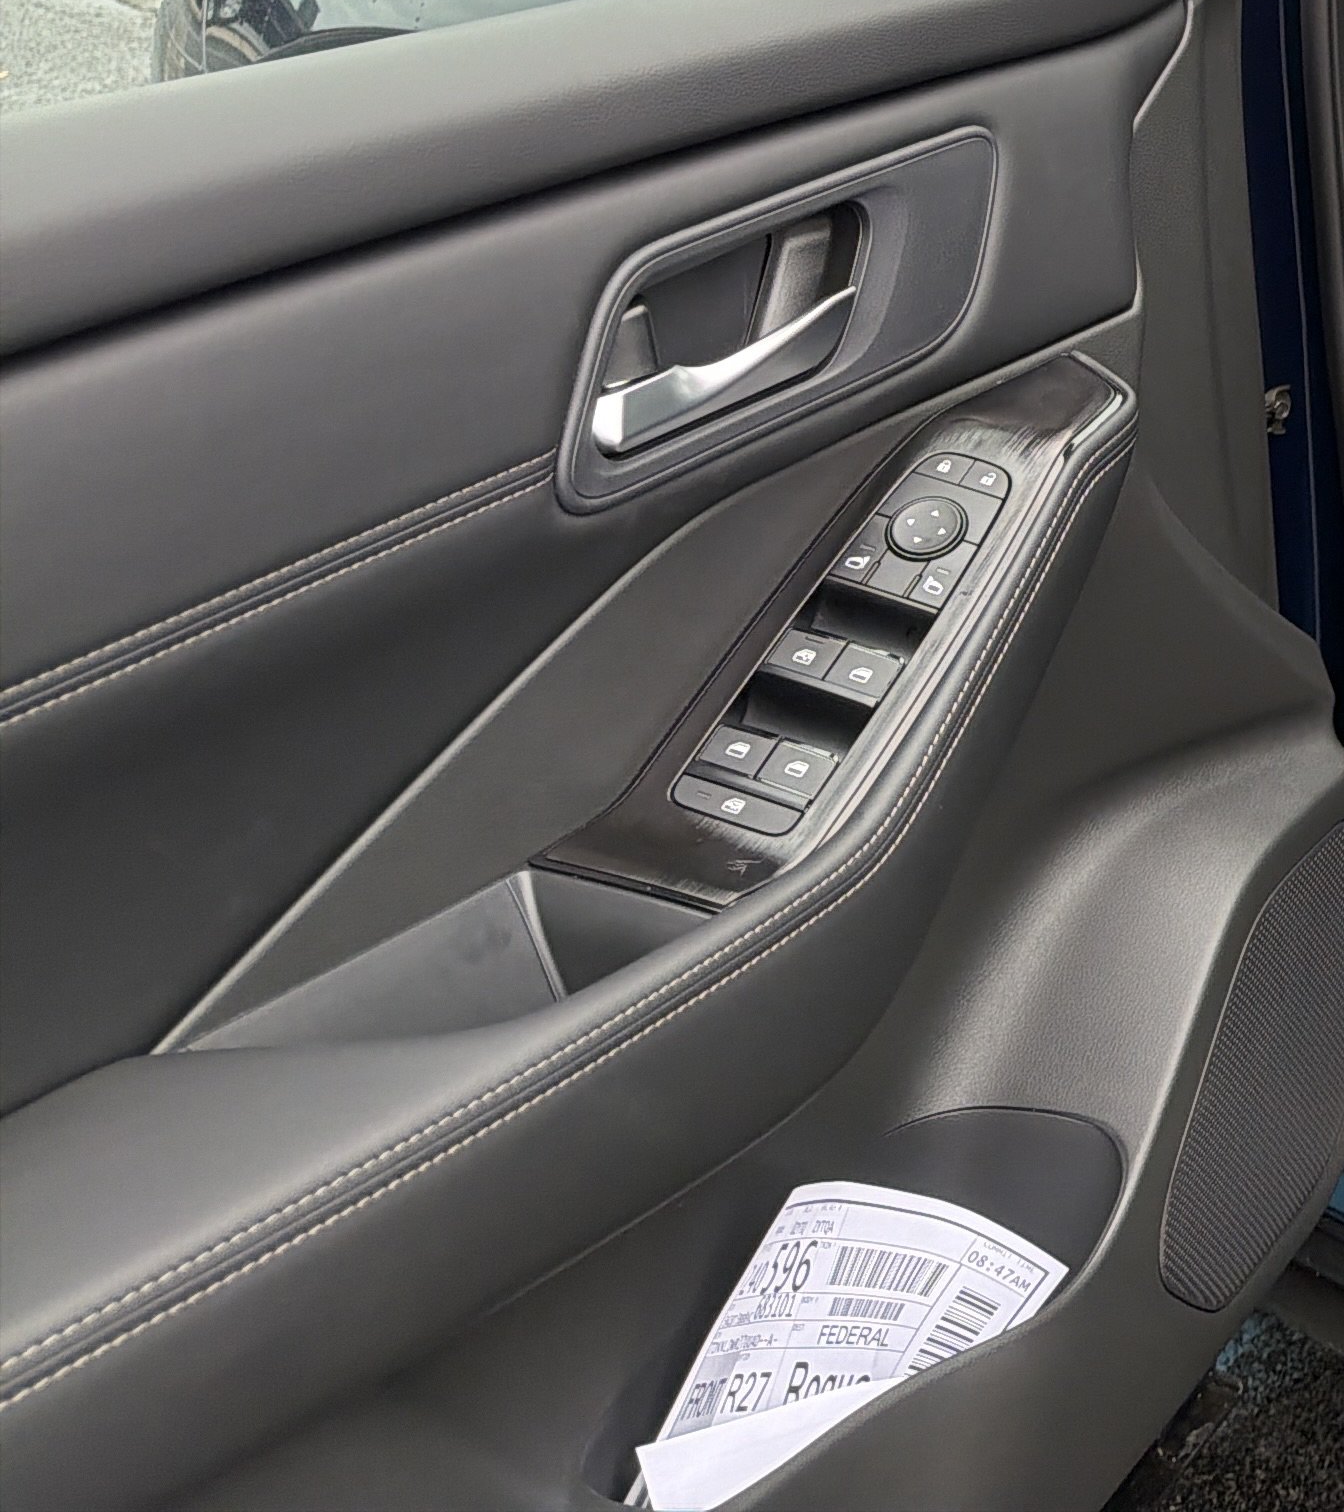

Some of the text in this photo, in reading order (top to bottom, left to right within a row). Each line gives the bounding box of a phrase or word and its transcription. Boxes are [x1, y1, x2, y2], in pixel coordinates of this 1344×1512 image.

[967, 1250, 1032, 1292] 08:47AM
[817, 1324, 890, 1347] FEDERAL
[679, 1377, 727, 1420] FRONT
[720, 1371, 773, 1414] R27
